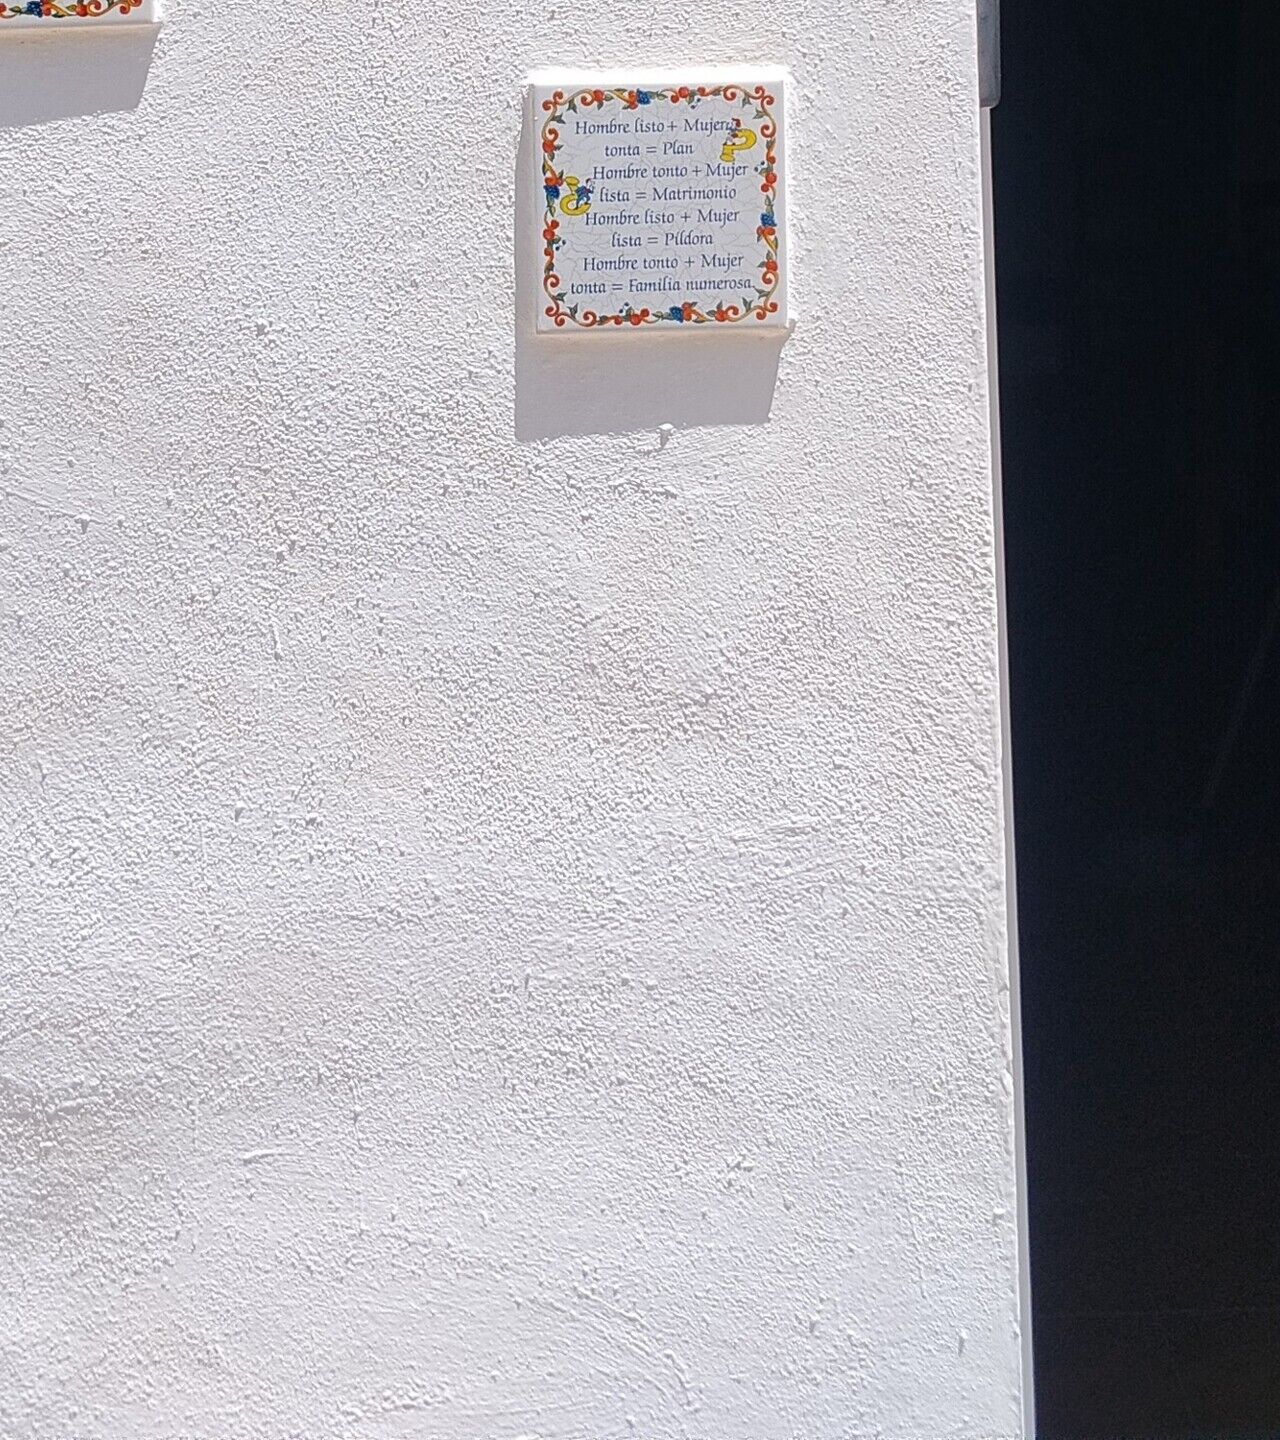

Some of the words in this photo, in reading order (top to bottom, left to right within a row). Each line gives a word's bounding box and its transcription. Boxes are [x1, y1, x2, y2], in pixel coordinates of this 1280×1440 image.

[575, 118, 631, 135] Hombre
[634, 117, 665, 133] listo
[666, 121, 678, 131] +
[683, 117, 729, 138] Mujer
[604, 144, 641, 157] tonta
[645, 146, 657, 154] =
[663, 139, 695, 155] Plan
[593, 163, 648, 180] Hombre
[652, 165, 688, 178] tonto
[692, 165, 702, 176] +
[706, 162, 749, 182] Mujer
[599, 186, 630, 203] lista
[652, 184, 737, 201] Matrimonio
[585, 209, 641, 226] Hombre
[644, 208, 675, 224] listo
[680, 211, 692, 222] +
[697, 208, 740, 229] Mujer
[611, 231, 642, 248] lista
[583, 254, 638, 271] Hombre
[643, 257, 679, 270] tonto
[684, 256, 695, 268] +
[701, 253, 745, 273] Mujer
[570, 282, 607, 294] tonta
[611, 283, 623, 291] =
[628, 275, 681, 293] Familia
